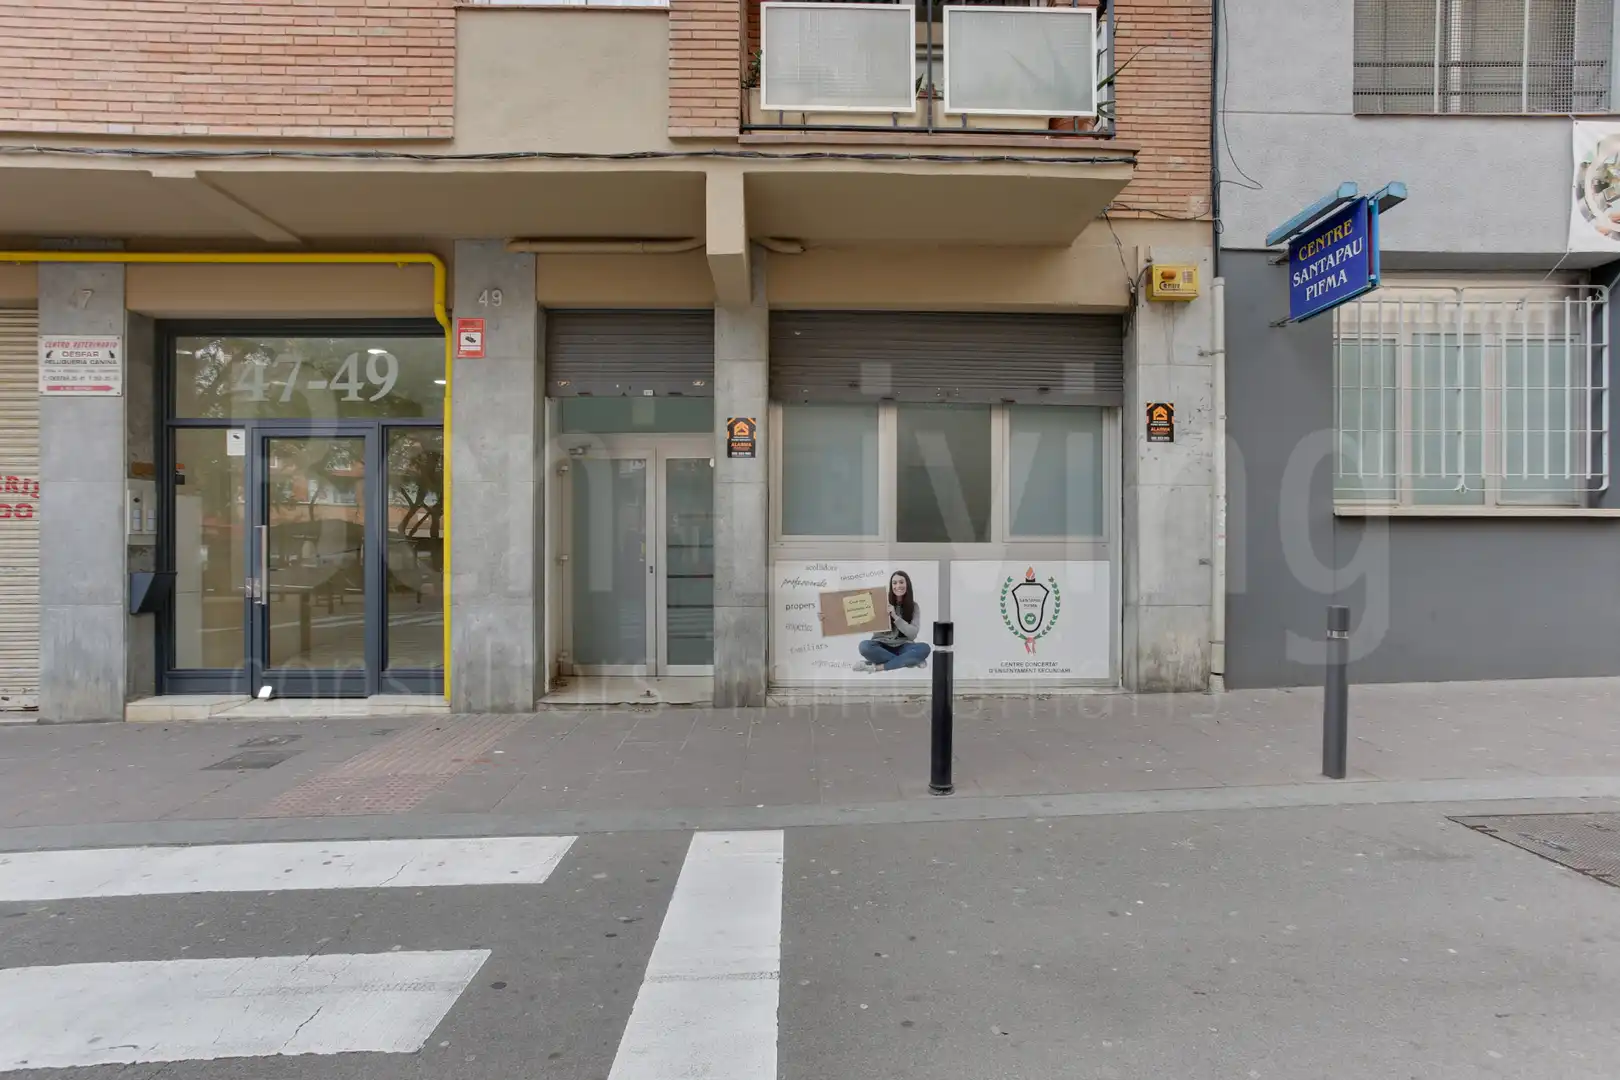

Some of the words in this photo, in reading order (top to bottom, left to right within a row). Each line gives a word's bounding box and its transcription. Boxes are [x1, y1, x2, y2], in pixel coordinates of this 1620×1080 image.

[1298, 219, 1354, 261] CENTRE
[1292, 237, 1364, 288] SANTAPAU
[477, 288, 503, 308] 49
[1305, 269, 1349, 302] PIFMA
[231, 351, 399, 402] 47-49
[785, 602, 816, 612] propers
